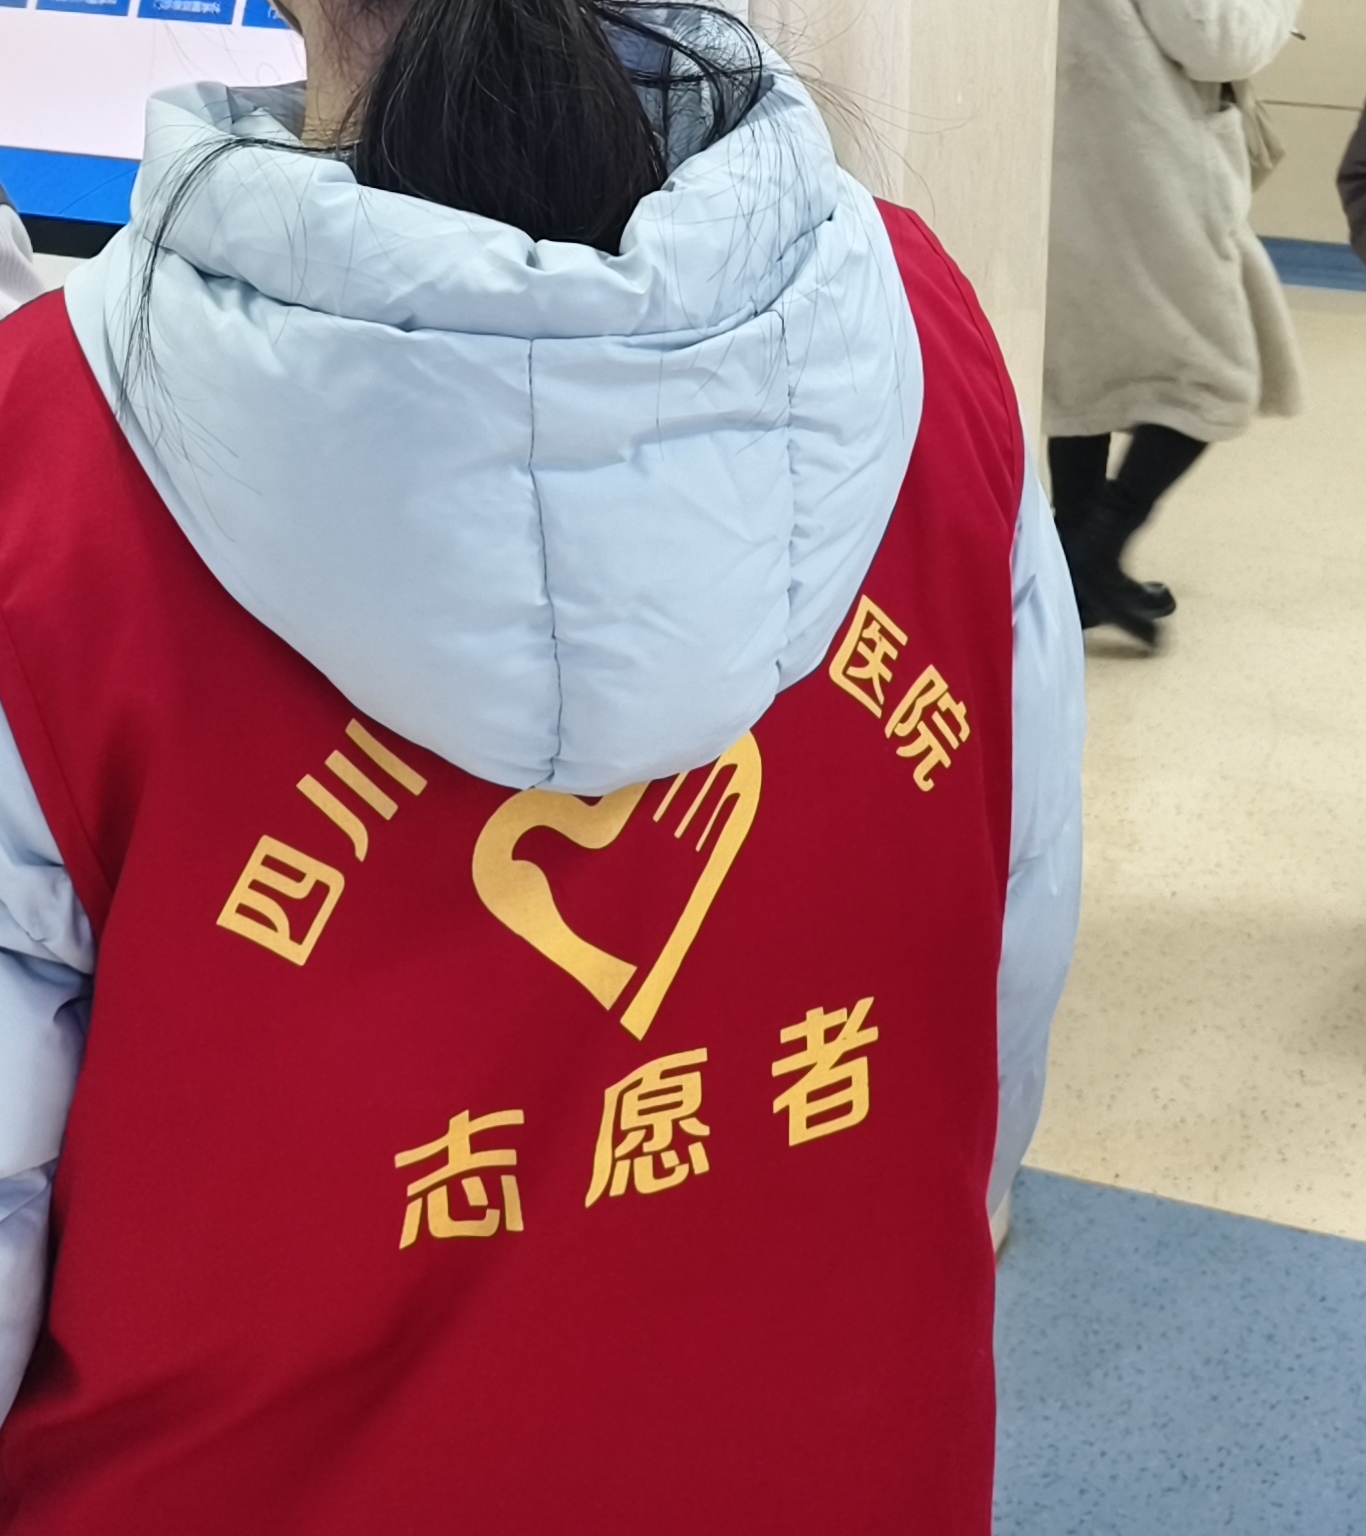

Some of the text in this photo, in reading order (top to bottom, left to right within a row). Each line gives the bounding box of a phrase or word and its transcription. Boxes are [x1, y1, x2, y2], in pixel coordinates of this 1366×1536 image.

[216, 594, 972, 967] 四川 医院
[394, 996, 880, 1251] 志愿者
